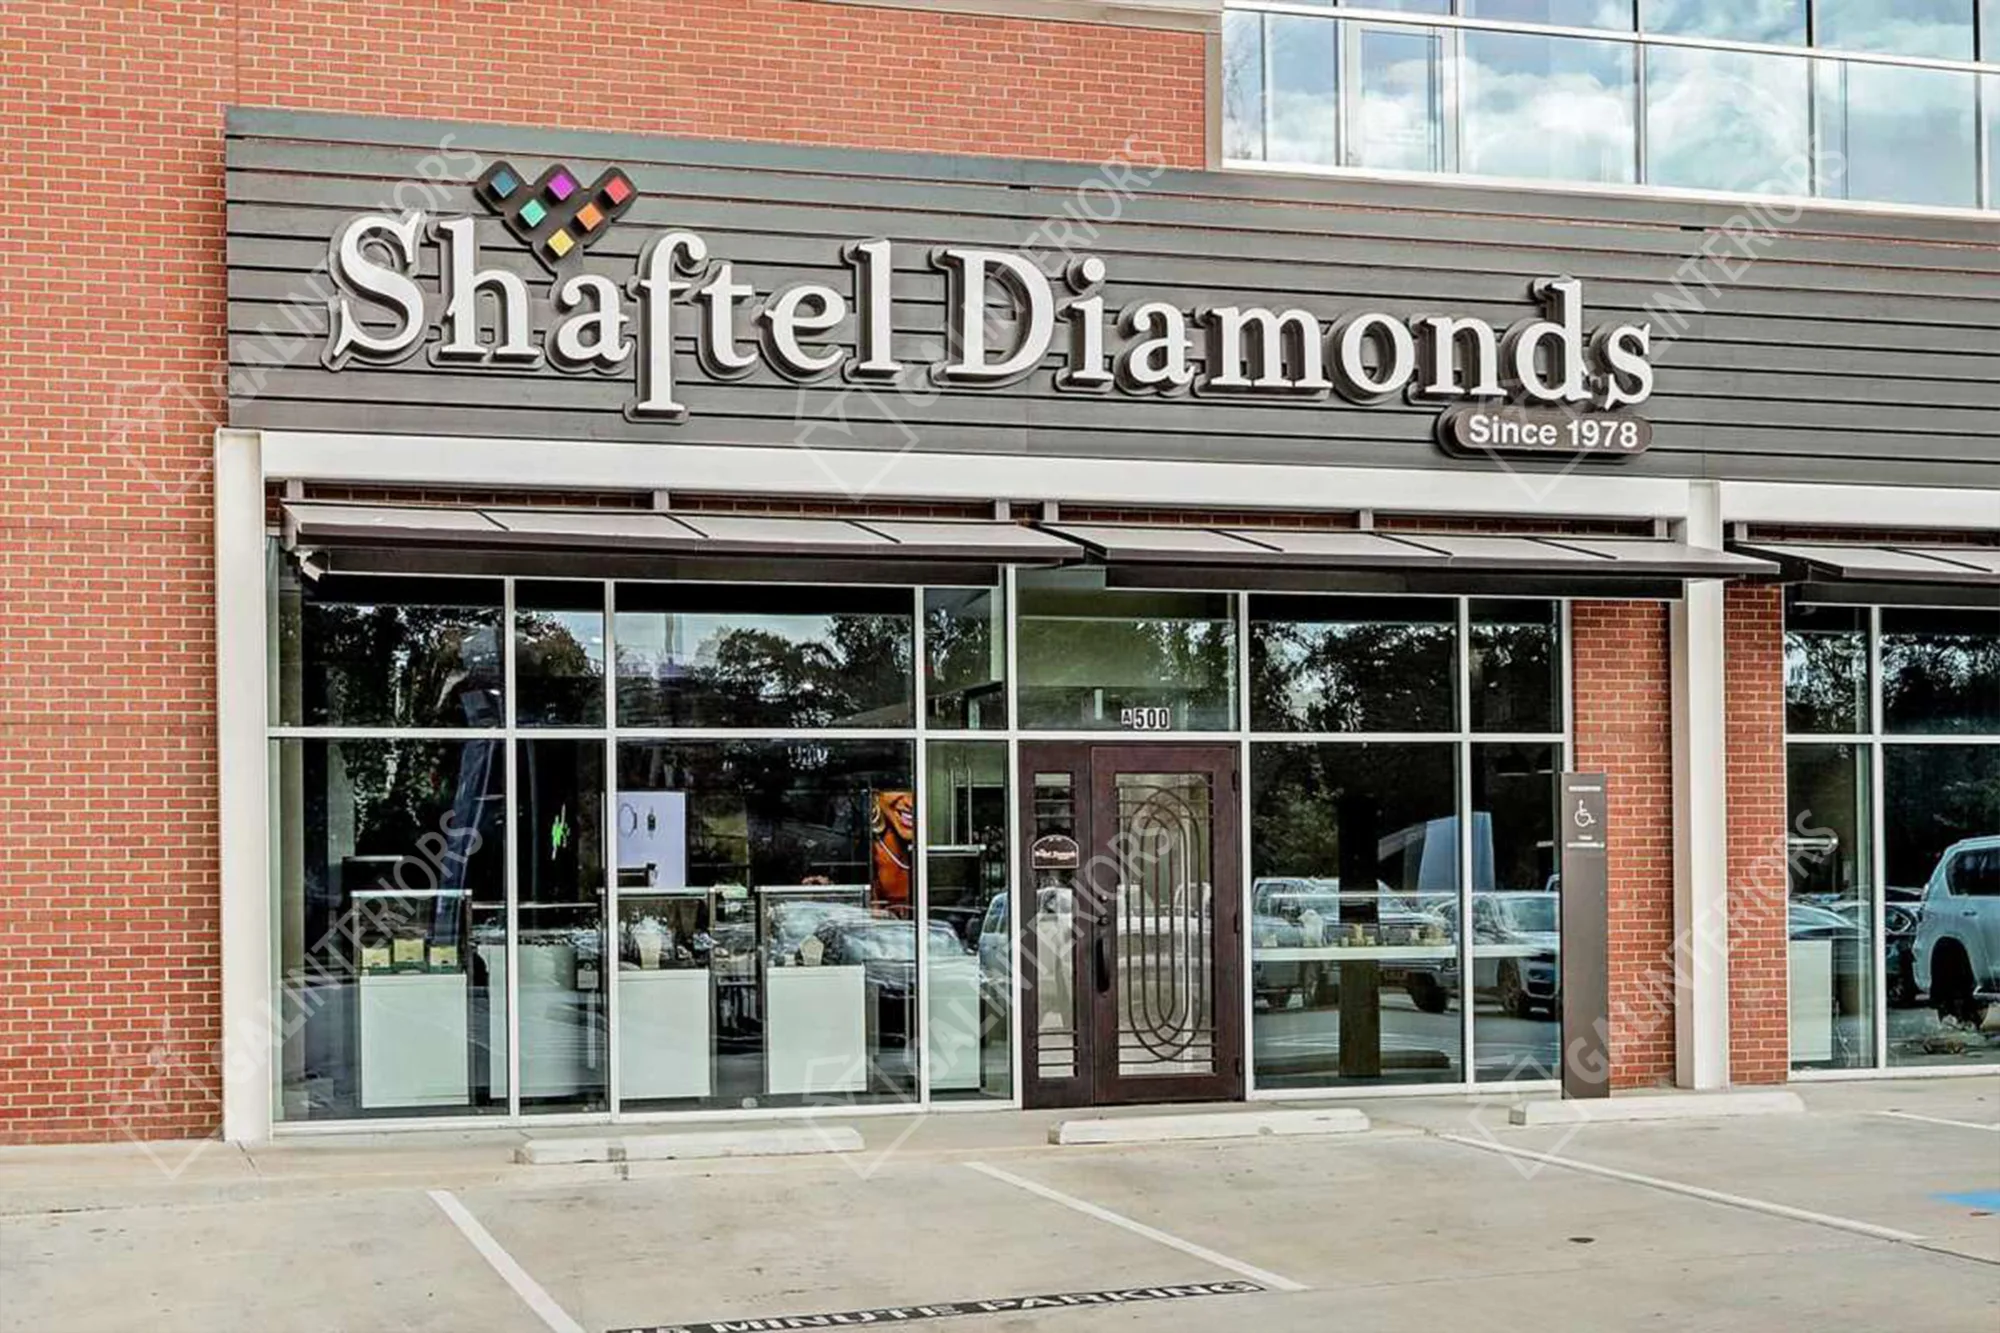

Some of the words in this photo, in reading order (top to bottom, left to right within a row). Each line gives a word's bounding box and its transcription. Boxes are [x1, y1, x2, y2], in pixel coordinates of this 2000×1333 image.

[333, 211, 903, 412] Shaftel
[945, 249, 1653, 410] Diamonds
[1469, 414, 1558, 445] Since
[1566, 419, 1638, 448] 1978
[710, 1304, 962, 1333] MINUTE
[977, 1282, 1262, 1311] PARKING
